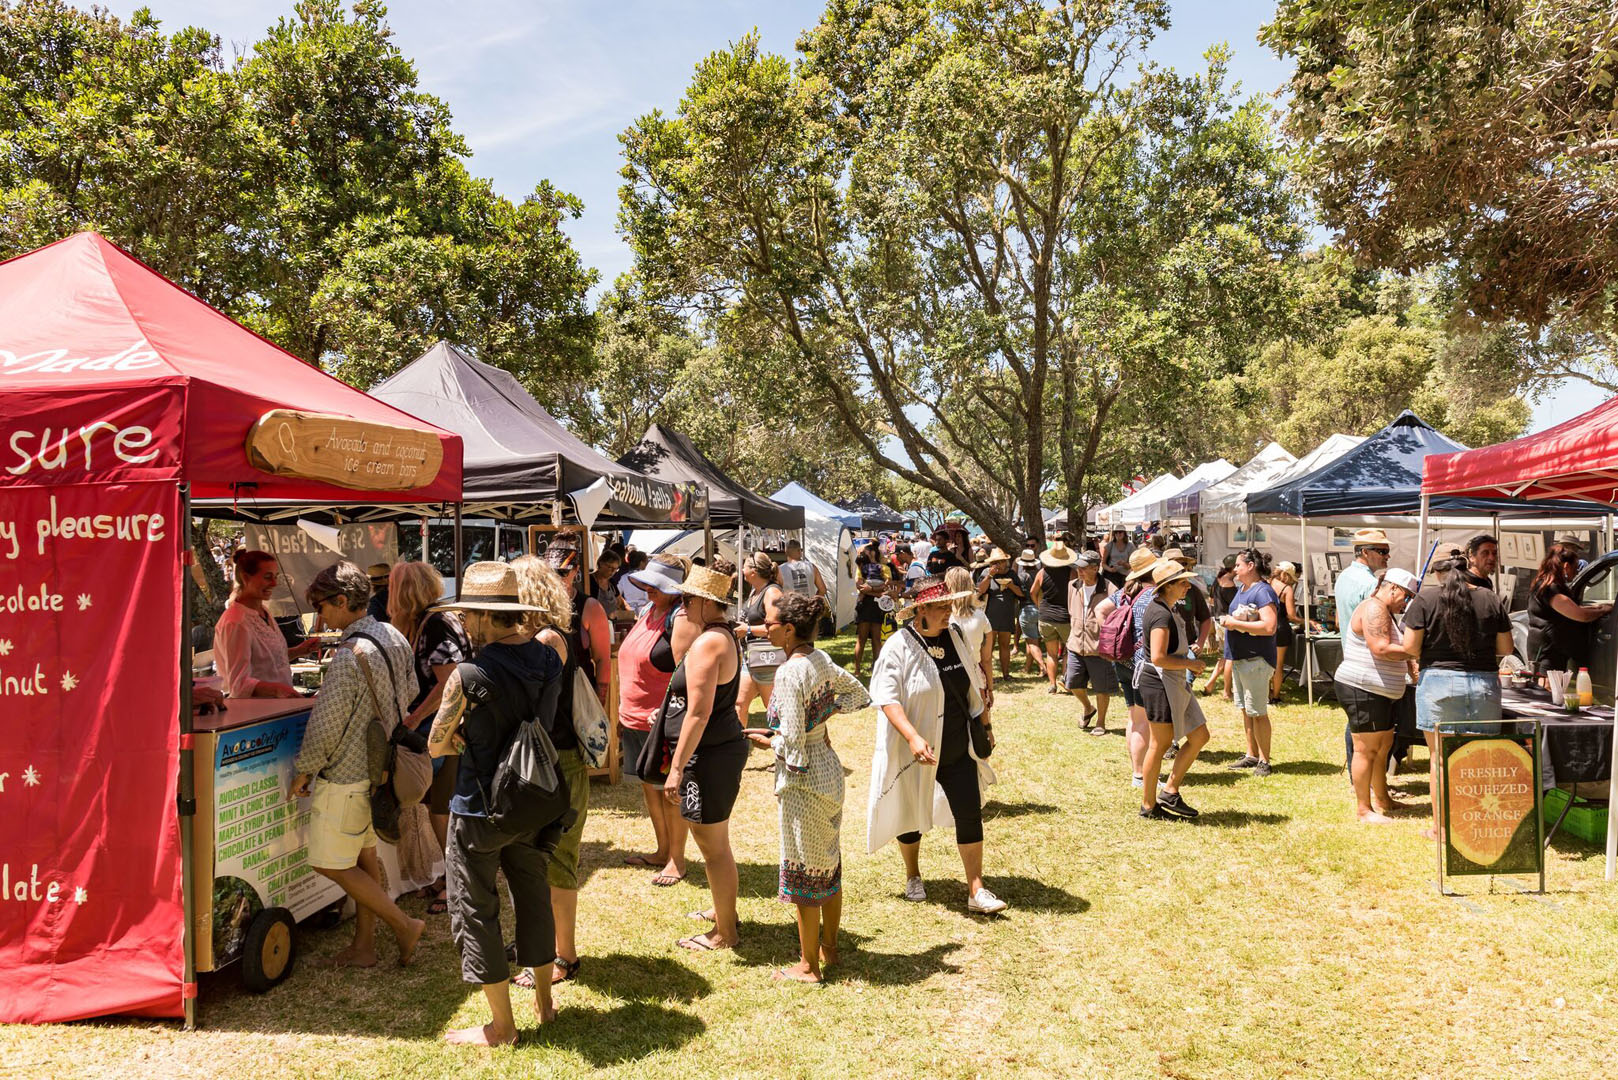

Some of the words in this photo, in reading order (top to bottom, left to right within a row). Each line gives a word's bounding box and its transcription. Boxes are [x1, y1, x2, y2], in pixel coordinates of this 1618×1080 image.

[5, 421, 160, 475] sure
[326, 427, 368, 453] Avocado
[373, 436, 393, 456] and
[396, 442, 428, 460] coconut
[344, 455, 360, 472] ice
[366, 461, 394, 475] cream
[400, 458, 417, 477] bars
[37, 495, 165, 555] pleasure
[1460, 767, 1519, 779] FRESHLY
[219, 784, 249, 805] AVOCOCO
[251, 775, 278, 794] CLASSIC
[1455, 783, 1528, 797] SQUEEZED
[219, 806, 238, 824] MINT
[246, 798, 264, 814] CHOC
[265, 792, 280, 807] CHIP
[1462, 810, 1522, 822] ORANGE
[219, 825, 242, 844] MAPLE
[244, 815, 265, 833] SYRUP
[1472, 827, 1513, 840] JUICE
[218, 836, 257, 863] CHOCOLATE
[2, 863, 60, 902] late
